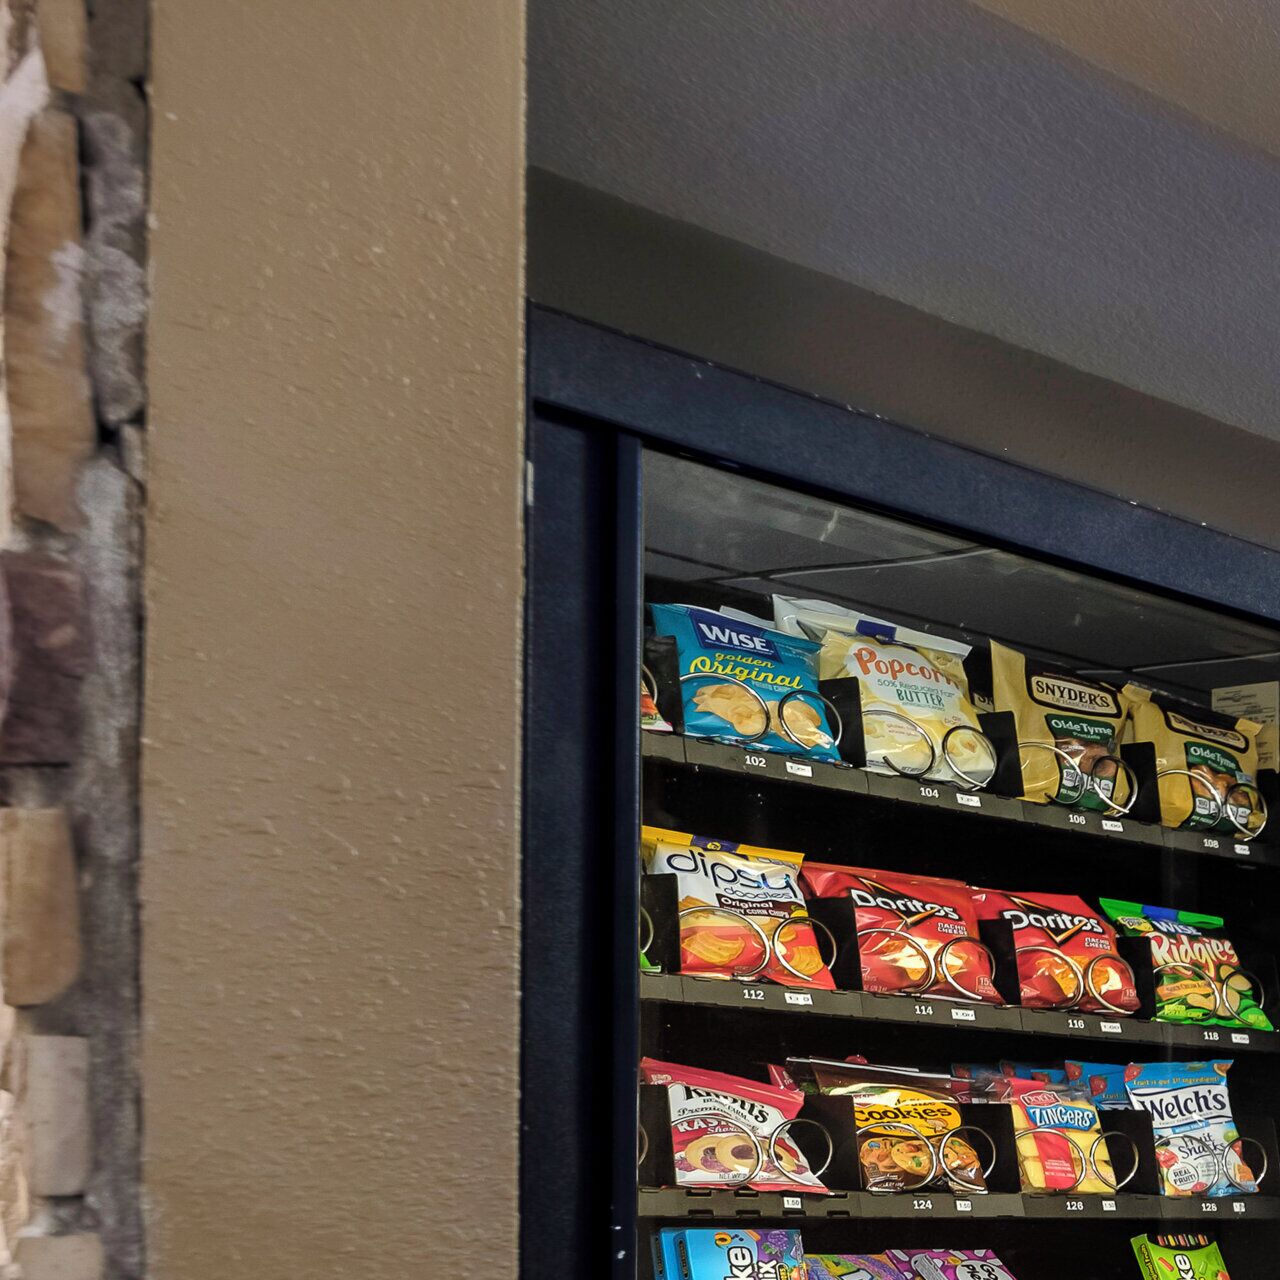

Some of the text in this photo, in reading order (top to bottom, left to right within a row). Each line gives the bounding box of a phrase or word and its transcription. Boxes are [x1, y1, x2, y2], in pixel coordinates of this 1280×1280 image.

[698, 622, 770, 652] WISE
[715, 652, 775, 668] golden
[690, 656, 803, 689] Original
[855, 647, 959, 690] Popcorn
[896, 688, 945, 707] BUTTER
[1035, 680, 1110, 709] SNYDER'S
[1051, 719, 1113, 737] Olde Tyme
[744, 754, 767, 768] 102
[919, 786, 939, 798] 104
[1069, 814, 1086, 825] 106
[1203, 838, 1219, 849] 108
[666, 849, 799, 899] dipsy
[723, 886, 793, 901] doodles
[720, 896, 774, 909] Original
[850, 888, 960, 921] Doritos
[1002, 909, 1104, 934] Doritos
[1151, 920, 1203, 936] WISE
[1144, 931, 1240, 978] Ridgies
[743, 988, 765, 1001] 112
[914, 1005, 934, 1016] 114
[1067, 1018, 1085, 1029] 116
[1203, 1031, 1220, 1041] 118
[1141, 1089, 1227, 1122] Welch's
[854, 1104, 953, 1124] Cookies
[1173, 1169, 1191, 1179] REAL
[786, 1198, 800, 1207] 1.50
[913, 1200, 933, 1210] 124
[1066, 1202, 1084, 1211] 126
[1201, 1203, 1217, 1212] 128
